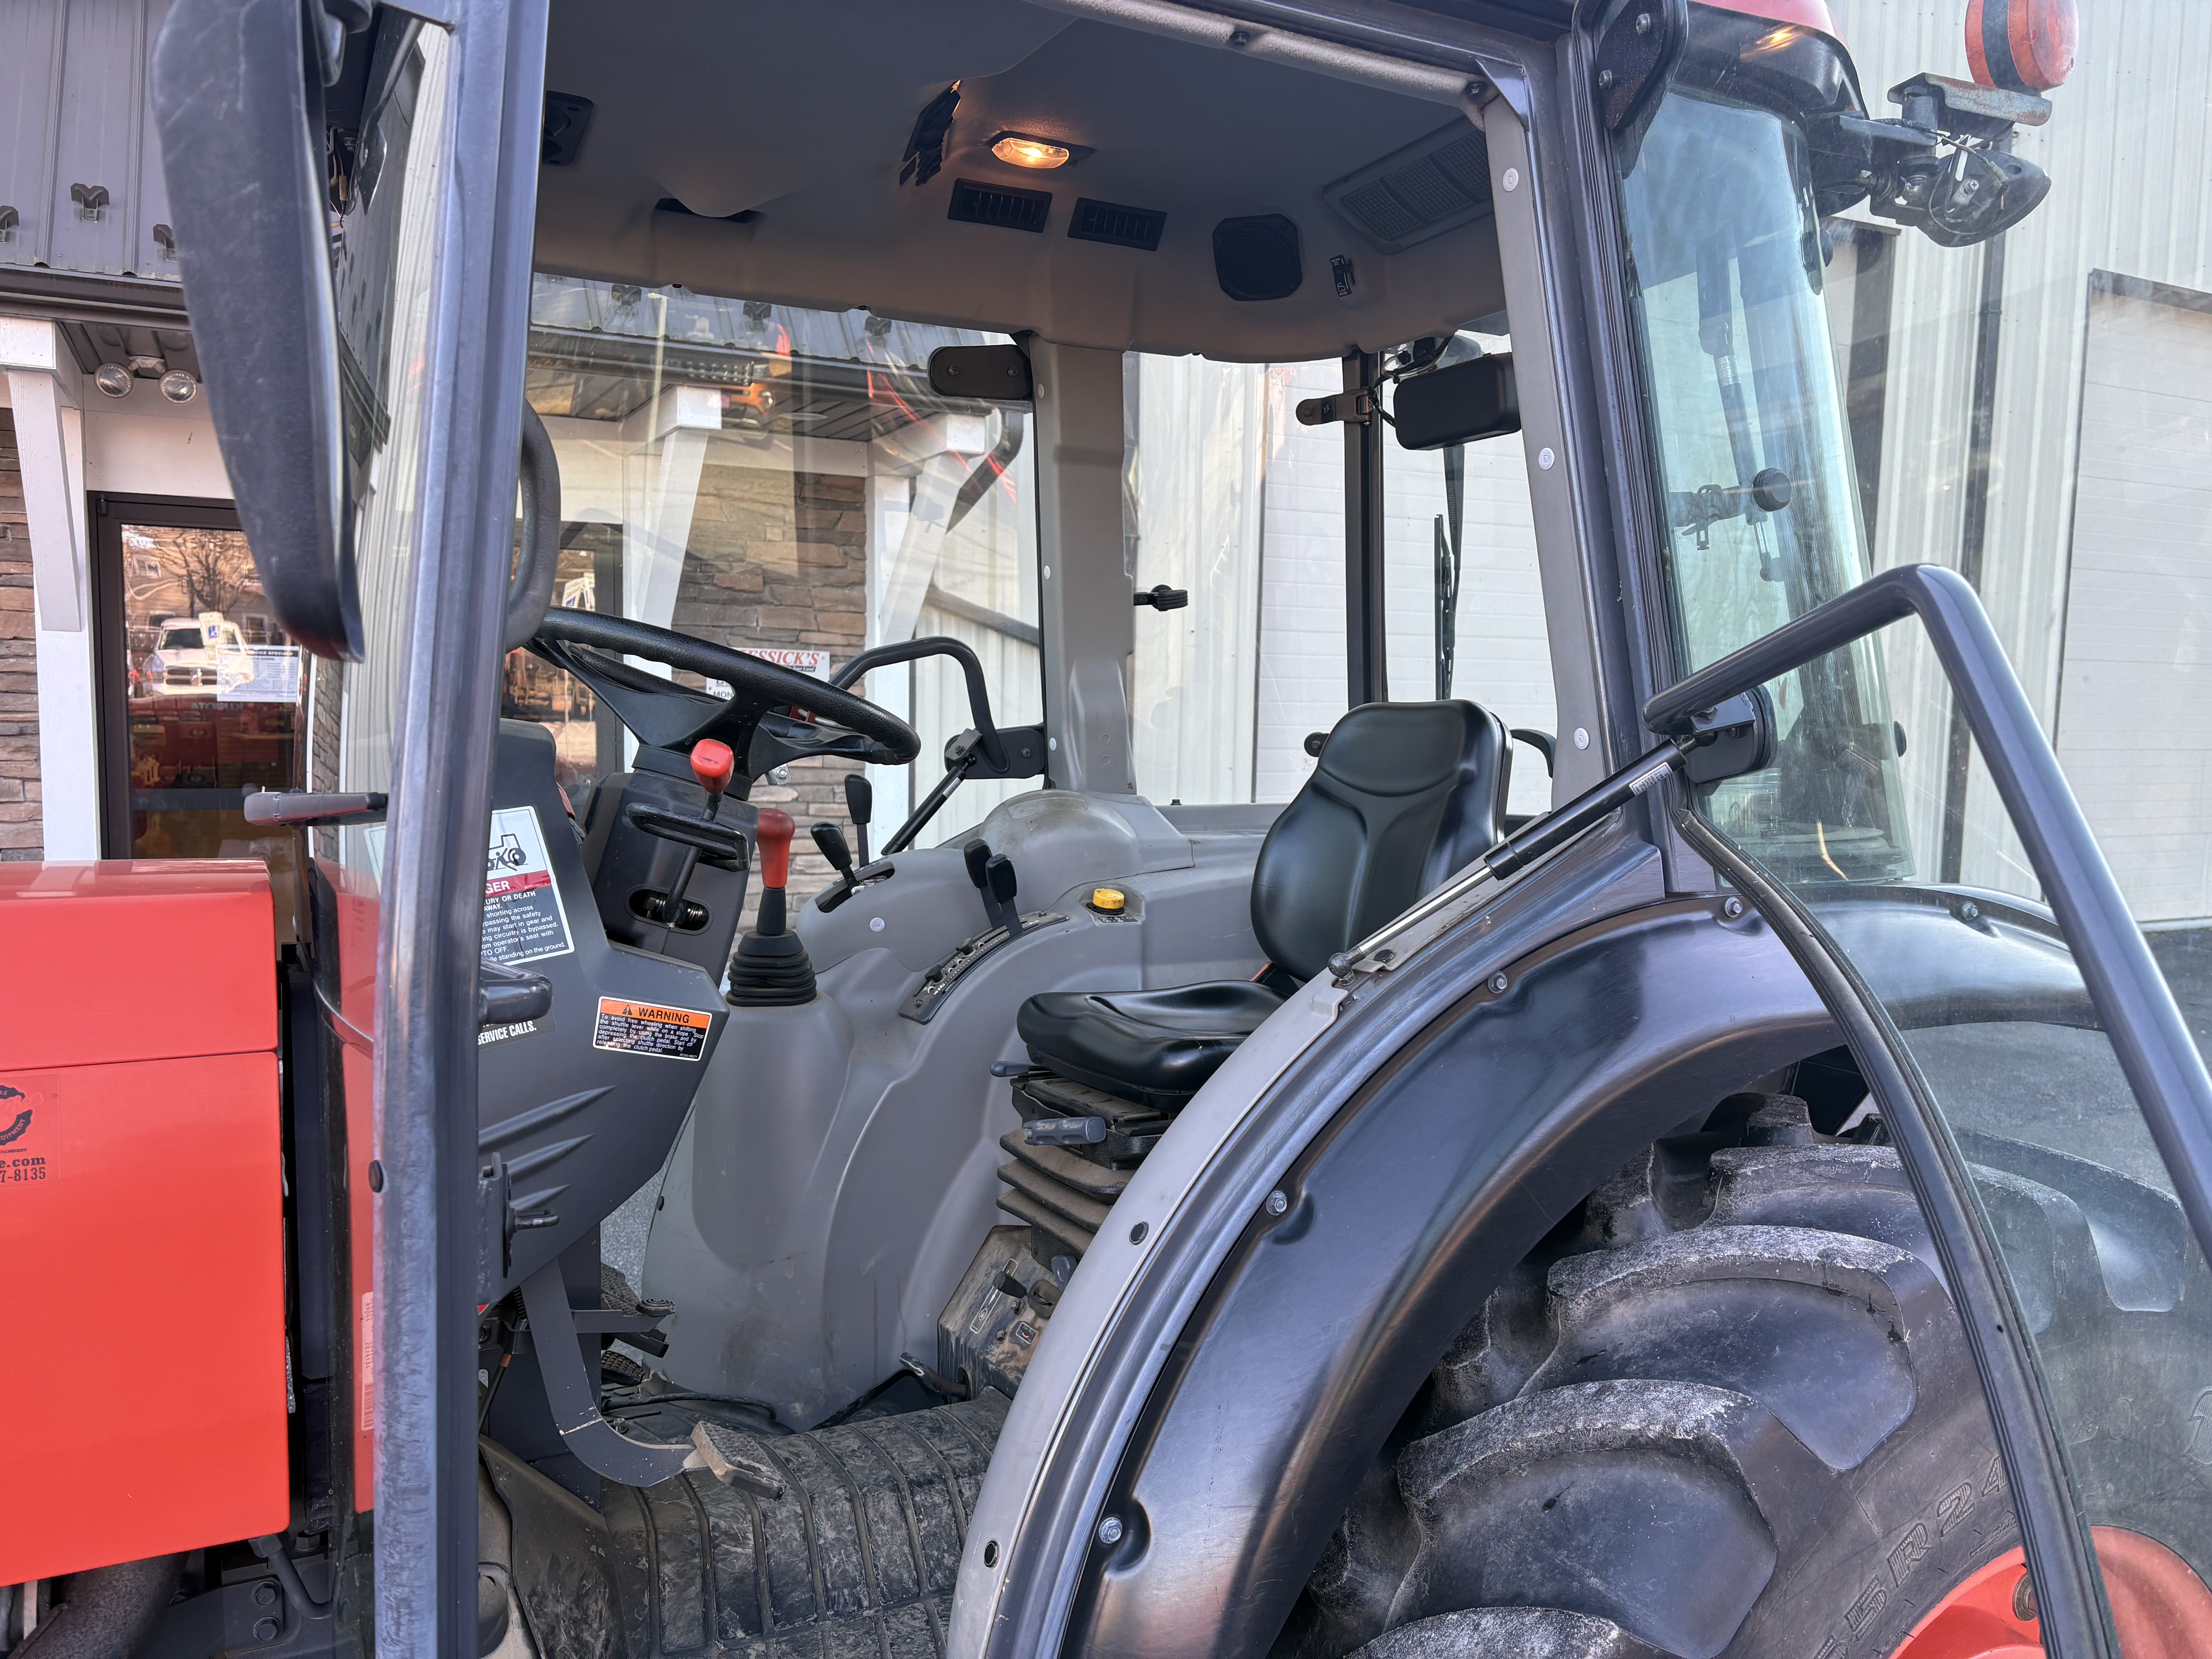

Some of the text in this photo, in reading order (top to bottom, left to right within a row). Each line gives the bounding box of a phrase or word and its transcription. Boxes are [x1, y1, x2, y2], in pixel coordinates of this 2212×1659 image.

[484, 897, 499, 905] URY
[514, 891, 536, 900] DEATH
[486, 909, 512, 918] shorting
[494, 930, 519, 939] circuitry
[528, 922, 558, 932] bypassed.
[498, 951, 524, 960] standing
[544, 942, 566, 952] ground.
[639, 1007, 689, 1023] WARNING
[599, 1025, 627, 1033] completely
[641, 1020, 663, 1029] wheeling
[477, 1020, 537, 1045] SERVICE CALLS.
[598, 1029, 627, 1038] depressing
[613, 1037, 635, 1045] selecting
